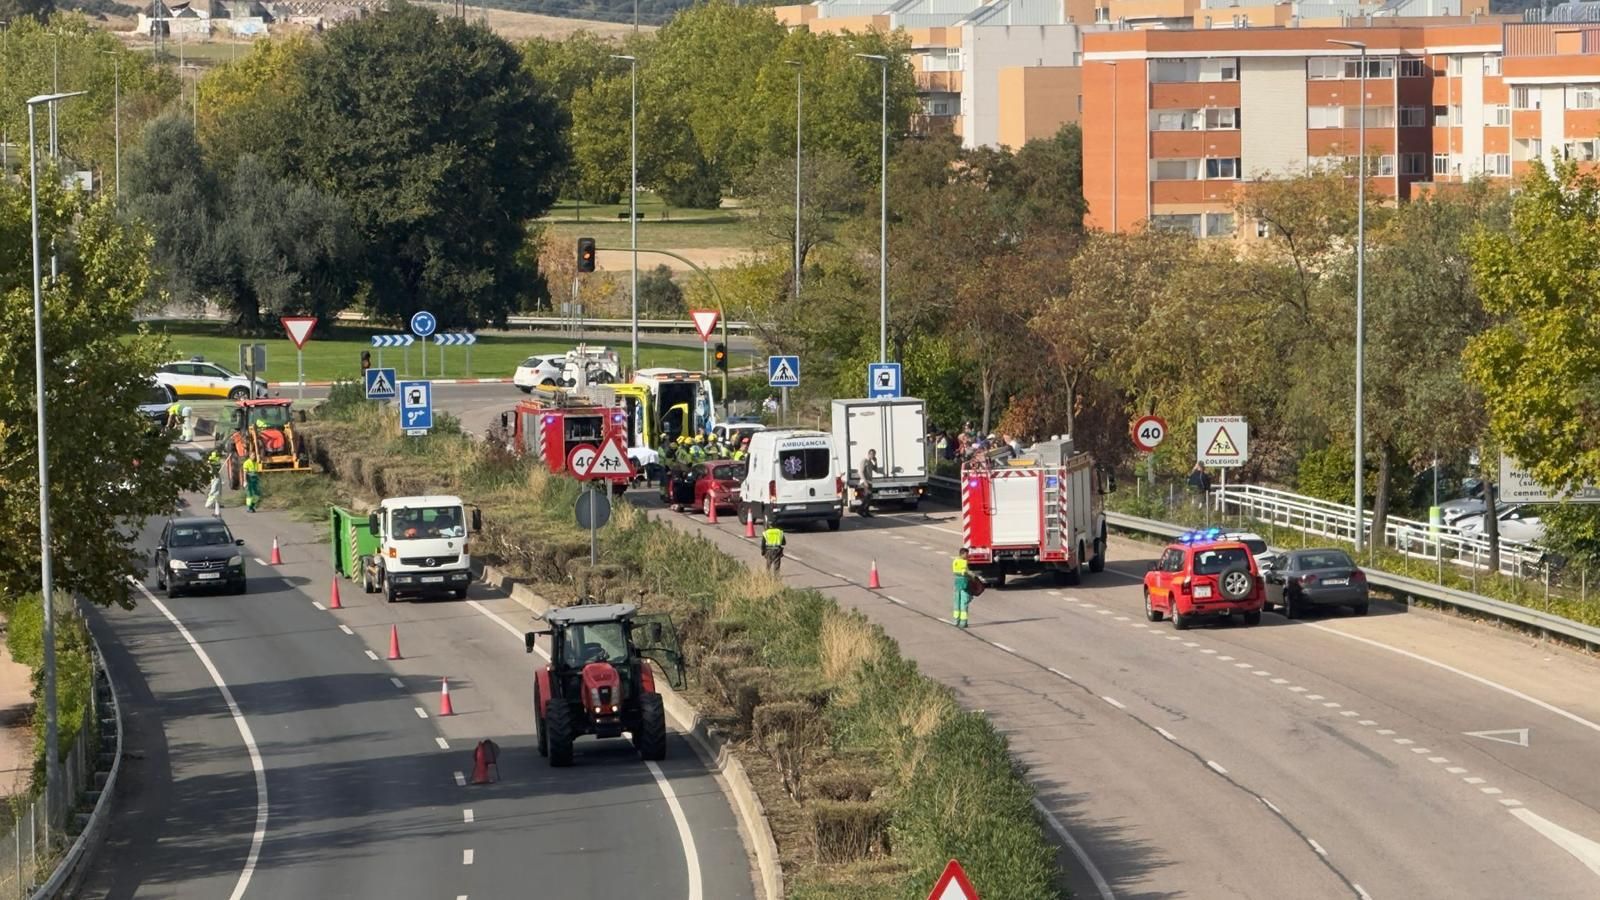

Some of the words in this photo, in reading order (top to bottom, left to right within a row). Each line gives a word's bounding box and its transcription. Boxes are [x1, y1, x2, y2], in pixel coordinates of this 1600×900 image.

[1140, 427, 1161, 440] 40
[782, 440, 827, 448] AMBULANCIA
[1509, 471, 1529, 480] Mejo
